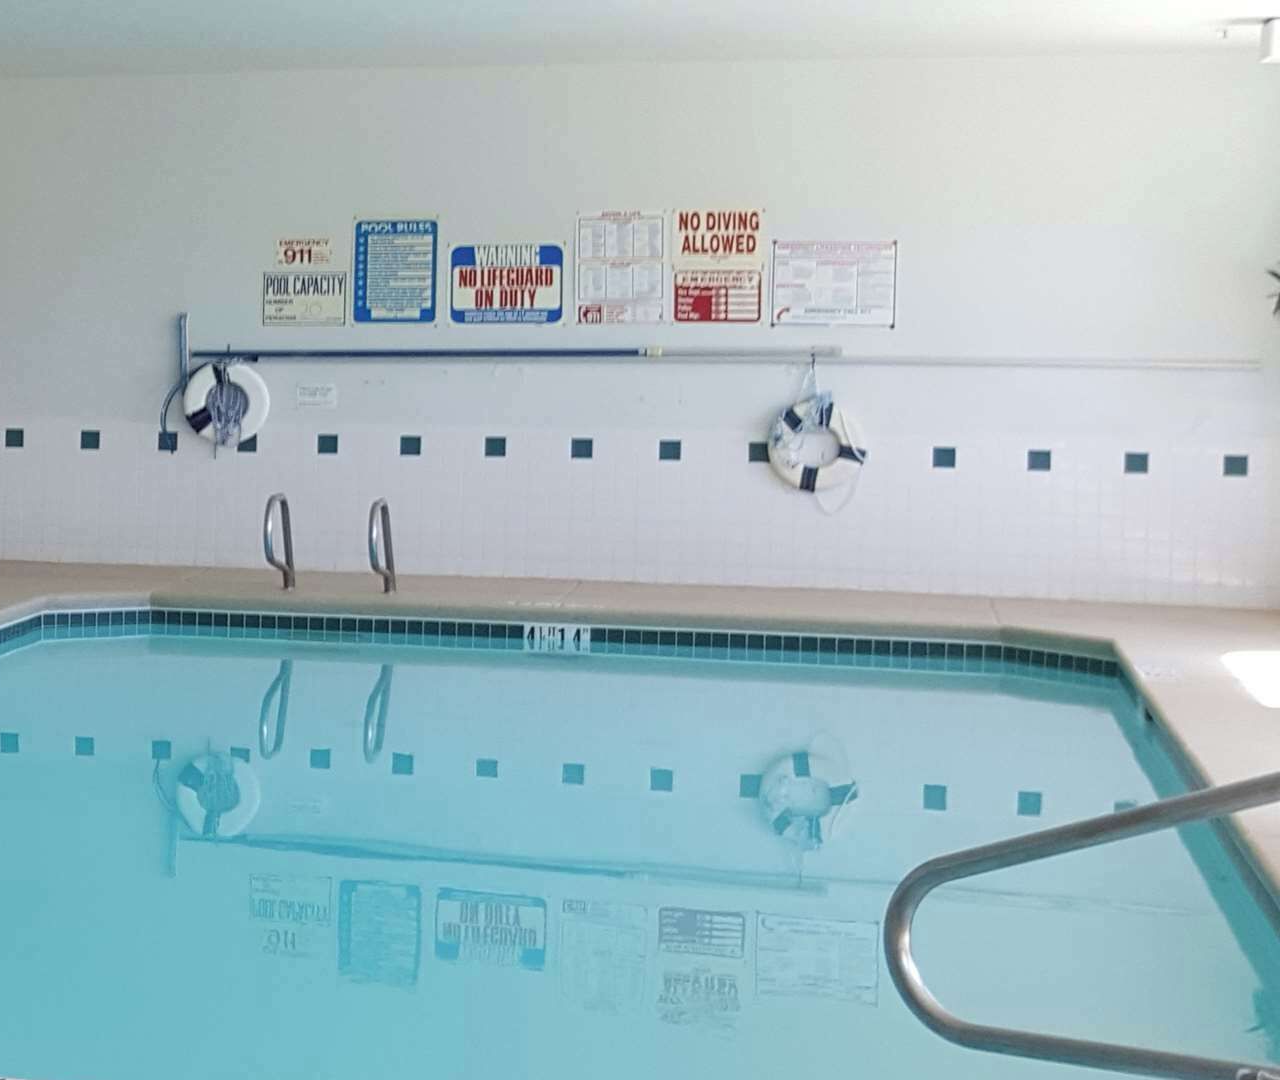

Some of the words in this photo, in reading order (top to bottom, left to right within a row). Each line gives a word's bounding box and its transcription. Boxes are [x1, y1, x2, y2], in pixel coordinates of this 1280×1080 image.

[678, 212, 701, 231] NO
[706, 212, 759, 231] DIVING
[681, 234, 756, 254] ALLOWED
[283, 248, 312, 264] 911
[476, 245, 540, 266] WARNING
[266, 274, 291, 296] POOL
[293, 274, 344, 296] CAPACITY
[459, 267, 477, 287] NO
[480, 267, 554, 287] LIFEGUARD
[475, 288, 494, 308] ON
[499, 288, 537, 308] DUTY
